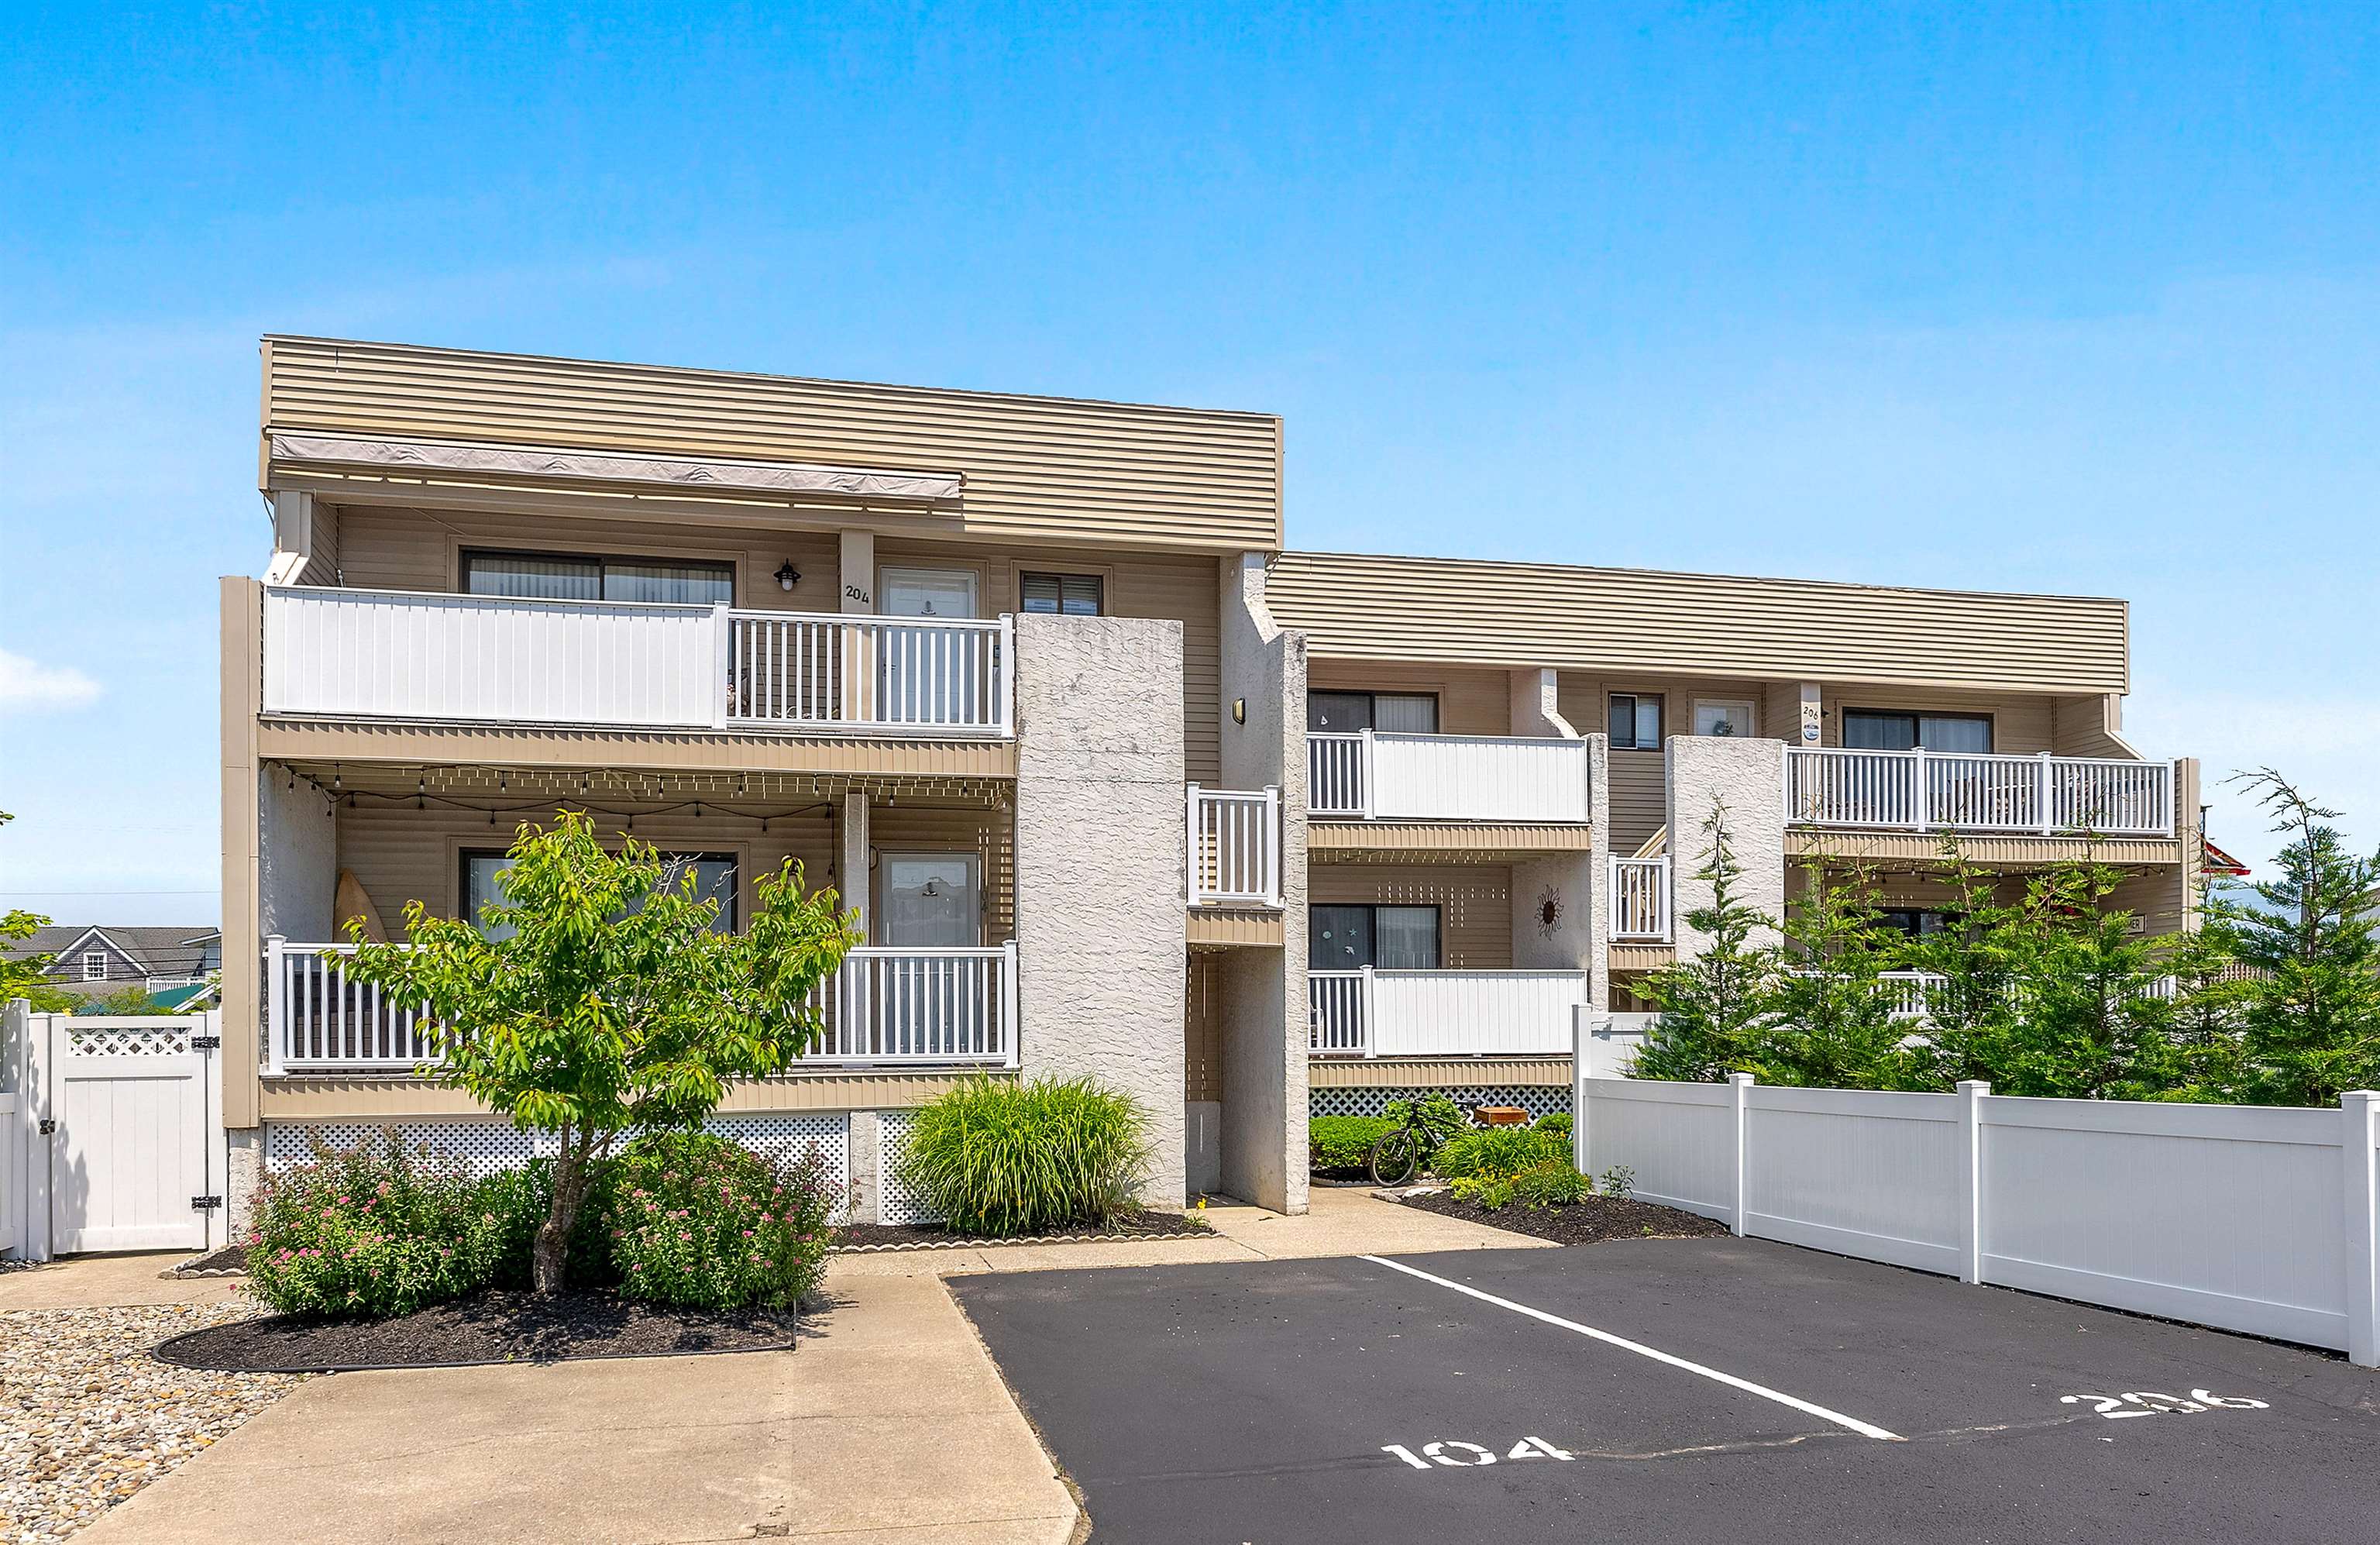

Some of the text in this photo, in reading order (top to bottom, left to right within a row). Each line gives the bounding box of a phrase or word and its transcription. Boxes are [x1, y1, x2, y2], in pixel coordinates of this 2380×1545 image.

[845, 585, 869, 604] 204
[1803, 706, 1818, 720] 206
[2060, 1388, 2270, 1419] 206
[1381, 1436, 1576, 1469] 104
